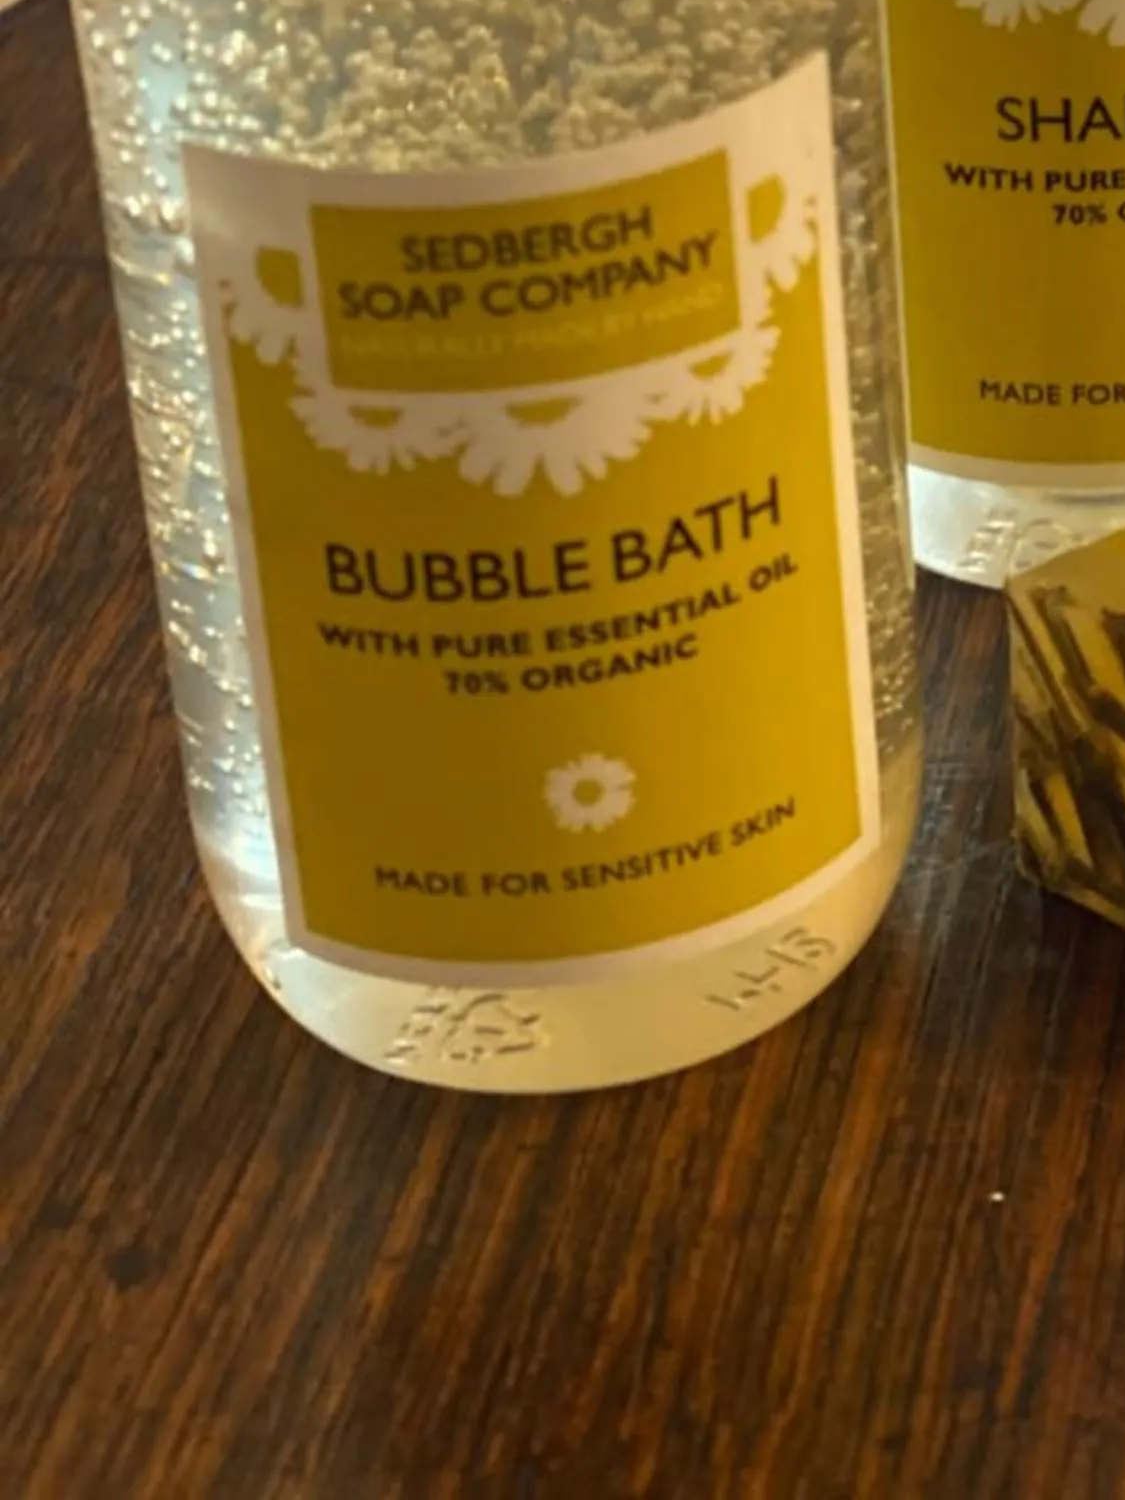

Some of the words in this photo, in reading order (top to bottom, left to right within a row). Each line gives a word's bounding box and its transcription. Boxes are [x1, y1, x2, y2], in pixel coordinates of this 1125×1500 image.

[944, 161, 1032, 193] WITH
[402, 205, 653, 274] SEDBERGH
[1053, 204, 1107, 226] 70%
[338, 282, 464, 322] SOAP
[479, 231, 719, 318] COMPANY
[979, 379, 1061, 406] MADE
[324, 541, 592, 602] BUBBLE
[612, 475, 781, 584] BATH
[317, 622, 419, 658] WITH
[432, 633, 532, 660] PURE
[546, 583, 741, 653] ESSENTIAL
[749, 553, 798, 592] OIL
[443, 669, 508, 695] 70%
[521, 634, 698, 692] ORGANIC
[375, 865, 466, 896] MADE
[481, 872, 551, 896] FOR
[561, 832, 720, 890] SENSITIVE
[730, 795, 796, 848] SKIN
